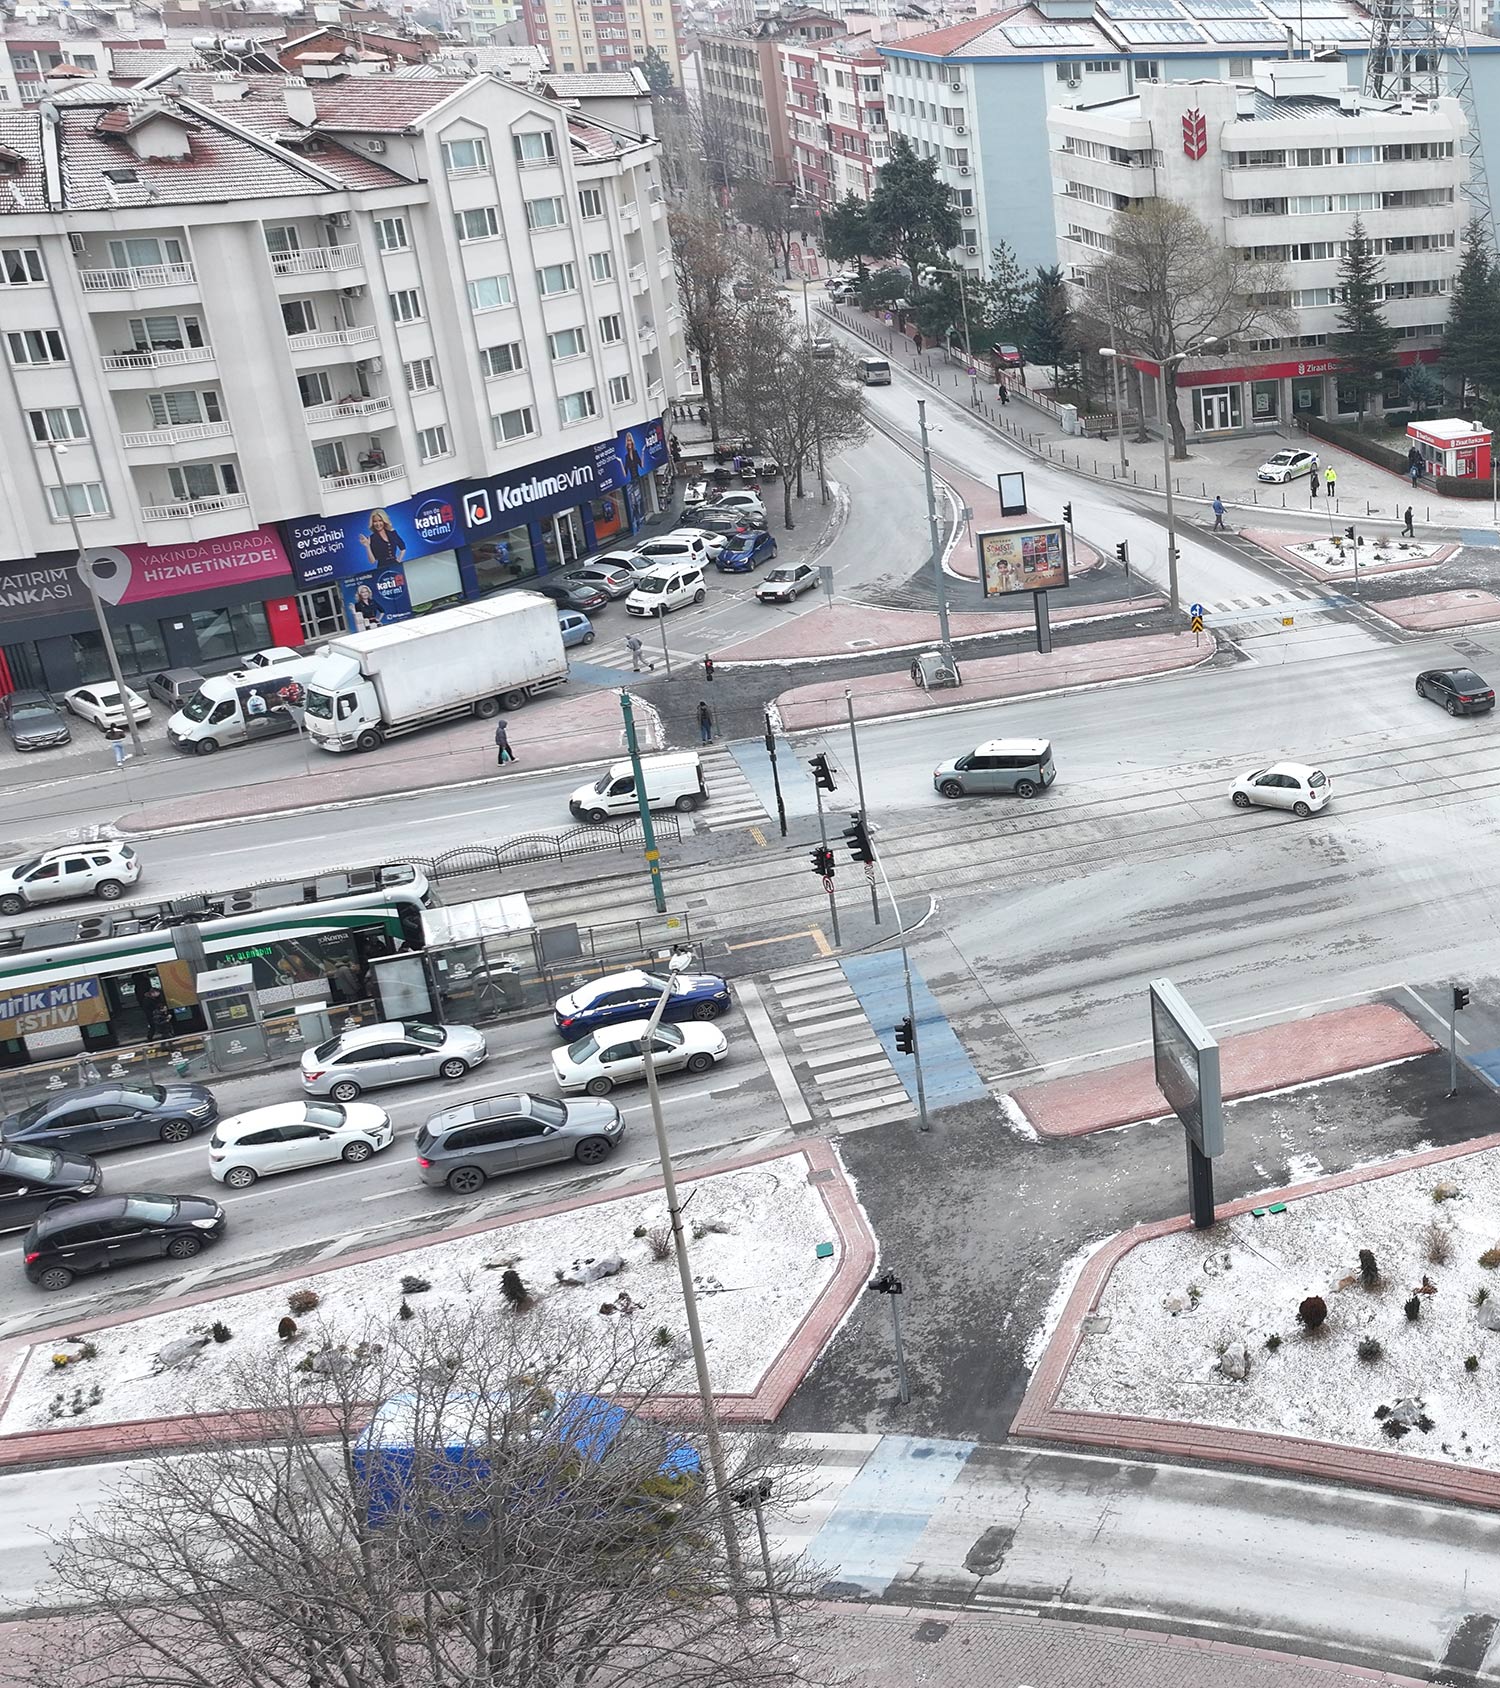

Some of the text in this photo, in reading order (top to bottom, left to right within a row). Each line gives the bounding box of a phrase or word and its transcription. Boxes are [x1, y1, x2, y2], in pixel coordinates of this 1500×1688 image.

[1306, 363, 1327, 373] Ziraat
[496, 465, 594, 512] Katılımevim
[414, 512, 443, 530] katıl
[421, 522, 451, 538] derim!
[294, 524, 327, 538] 5 ayda
[297, 528, 345, 549] ev sahibi
[139, 535, 273, 567] YAKINDA BURADA
[299, 541, 345, 559] olmak için
[0, 568, 69, 590] ATIRIM
